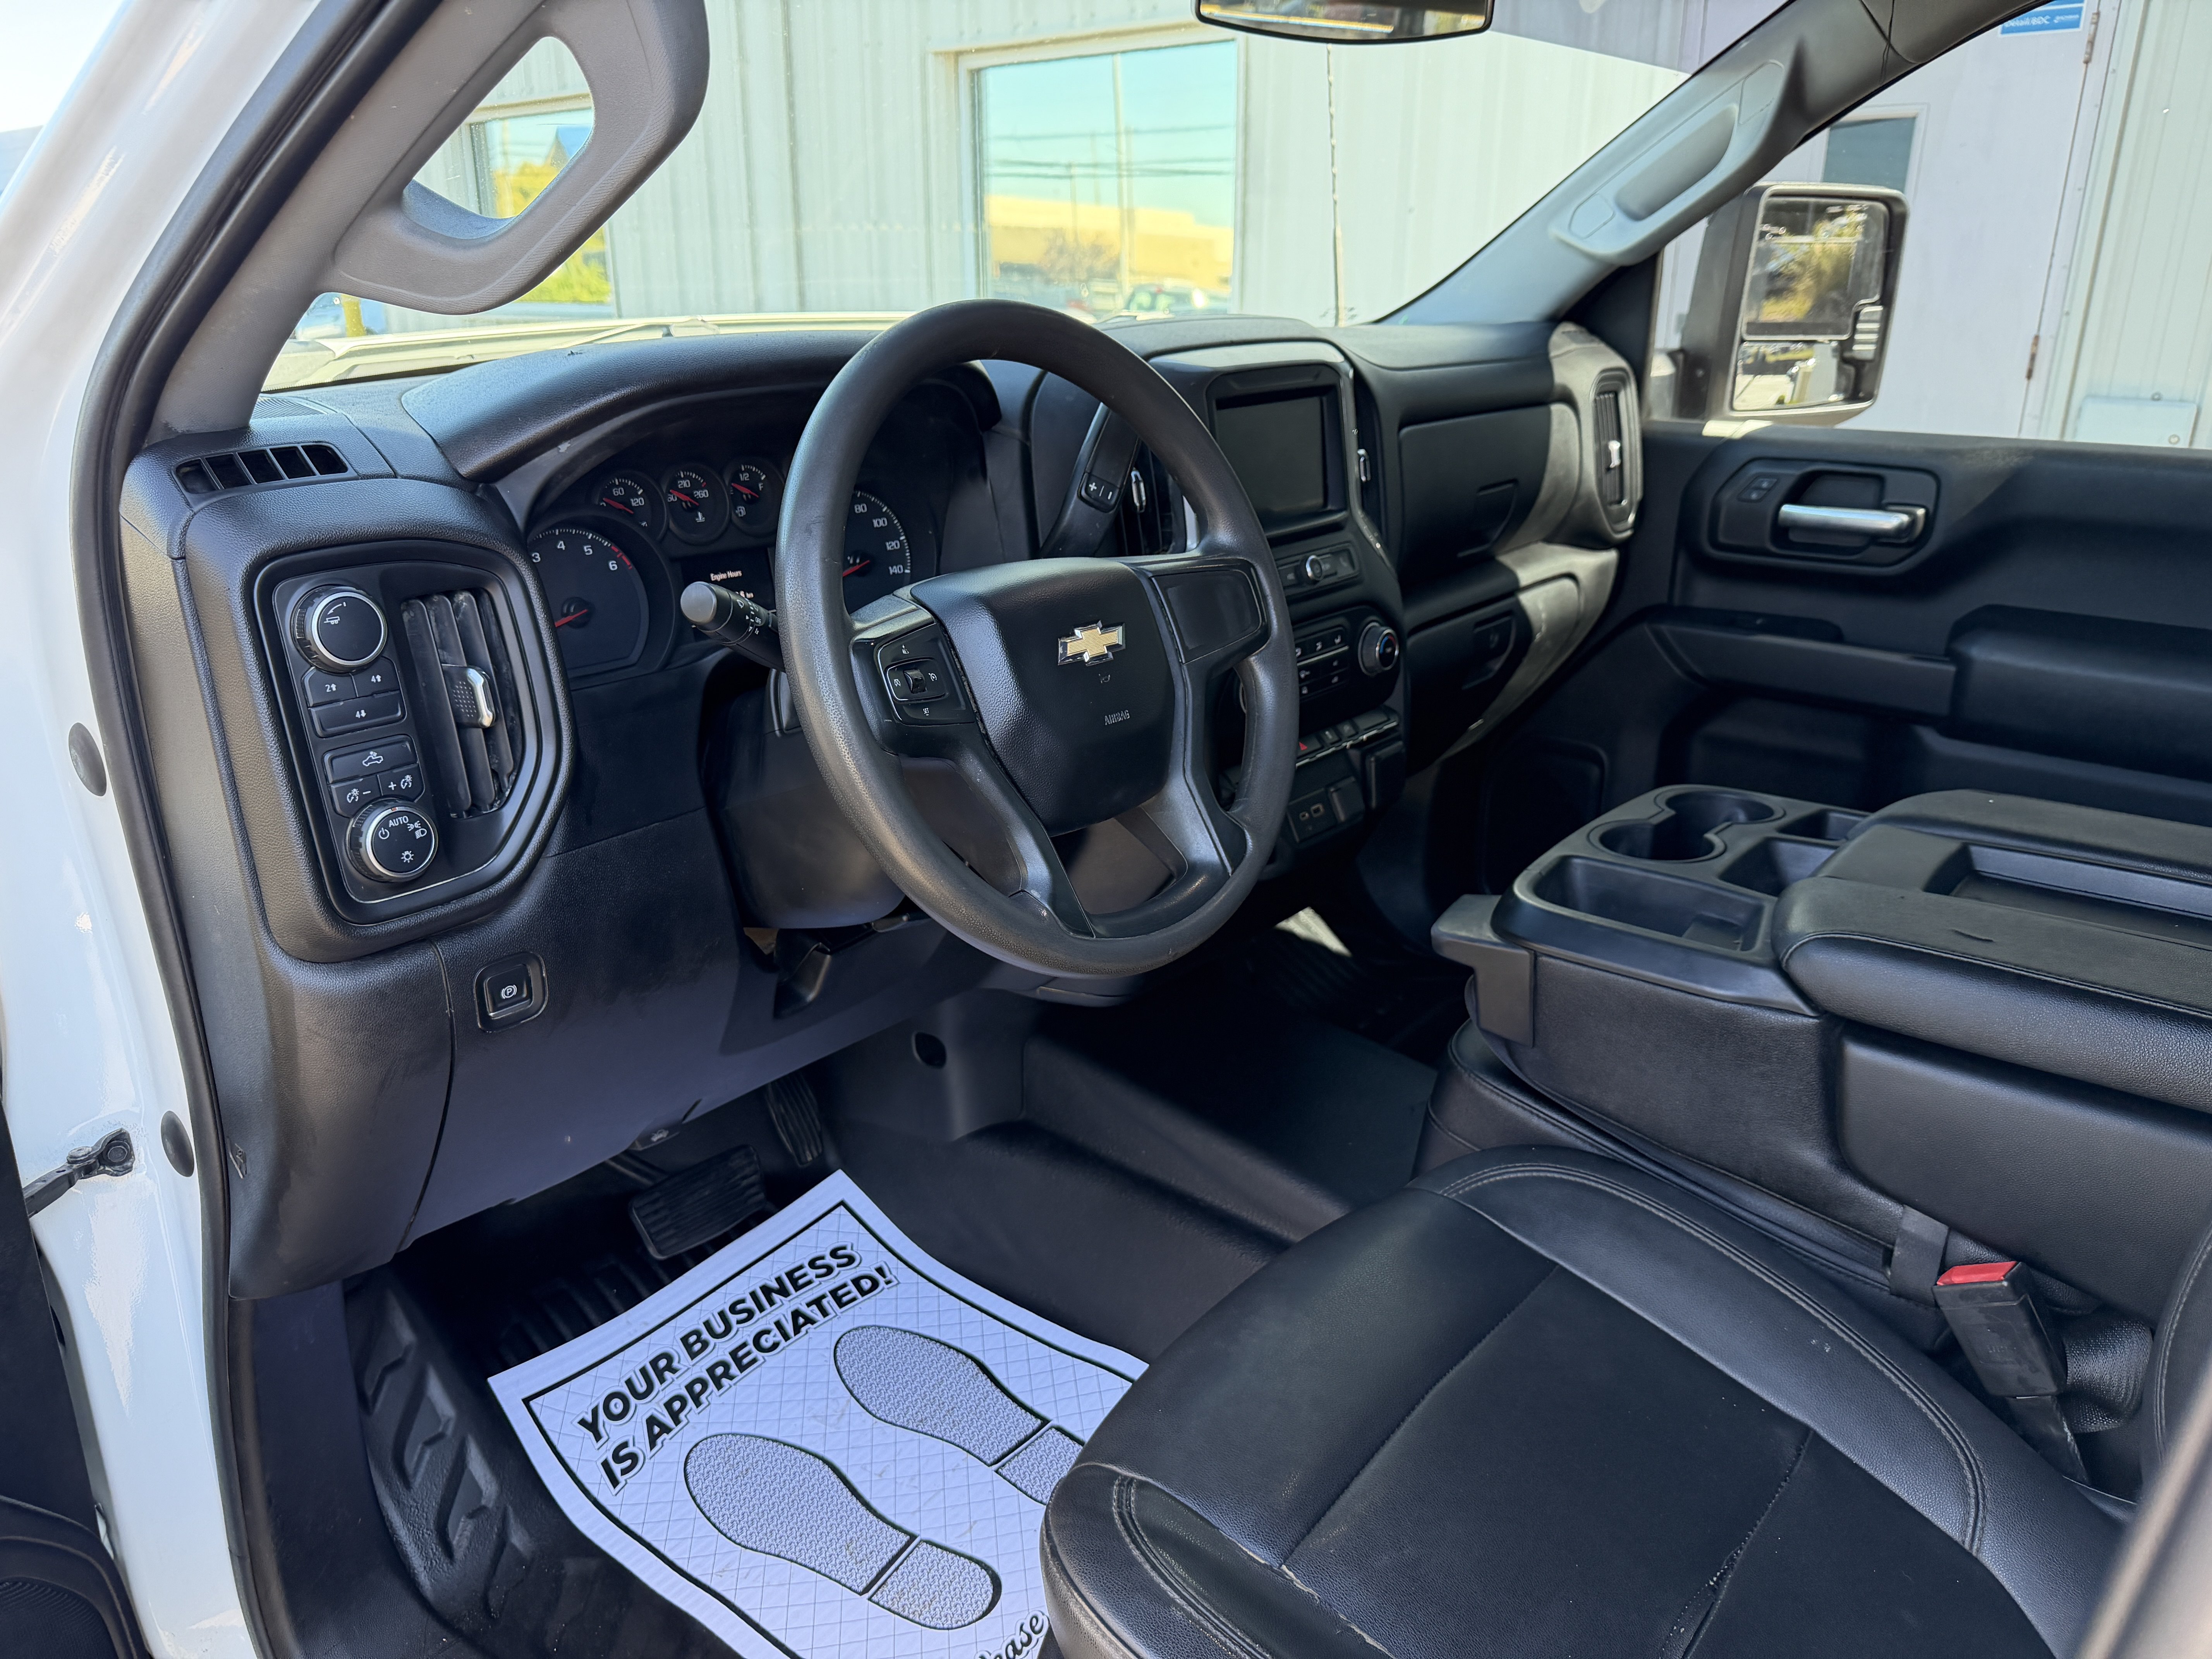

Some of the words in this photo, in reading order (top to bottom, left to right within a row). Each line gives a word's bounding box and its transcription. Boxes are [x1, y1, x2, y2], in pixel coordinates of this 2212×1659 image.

[739, 472, 749, 481] 1/2
[678, 479, 690, 488] 210
[758, 483, 764, 491] F
[613, 487, 625, 496] 60
[694, 489, 709, 499] 260
[630, 497, 645, 507] 120
[854, 503, 867, 514] 80
[872, 517, 888, 528] 100
[557, 541, 566, 550] 4
[583, 544, 593, 555] 5
[885, 540, 900, 551] 120
[532, 552, 541, 562] 3
[608, 560, 618, 571] 6
[888, 564, 903, 575] 140
[710, 572, 727, 581] Engine
[726, 570, 742, 578] Hours
[325, 684, 331, 692] 2
[1104, 709, 1130, 725] AIRBAG
[389, 815, 409, 828] AUTO
[576, 1352, 680, 1444] YOUR
[678, 1244, 857, 1361] BUSINESS
[598, 1440, 640, 1490] IS
[644, 1265, 893, 1453] APPRECIATED!
